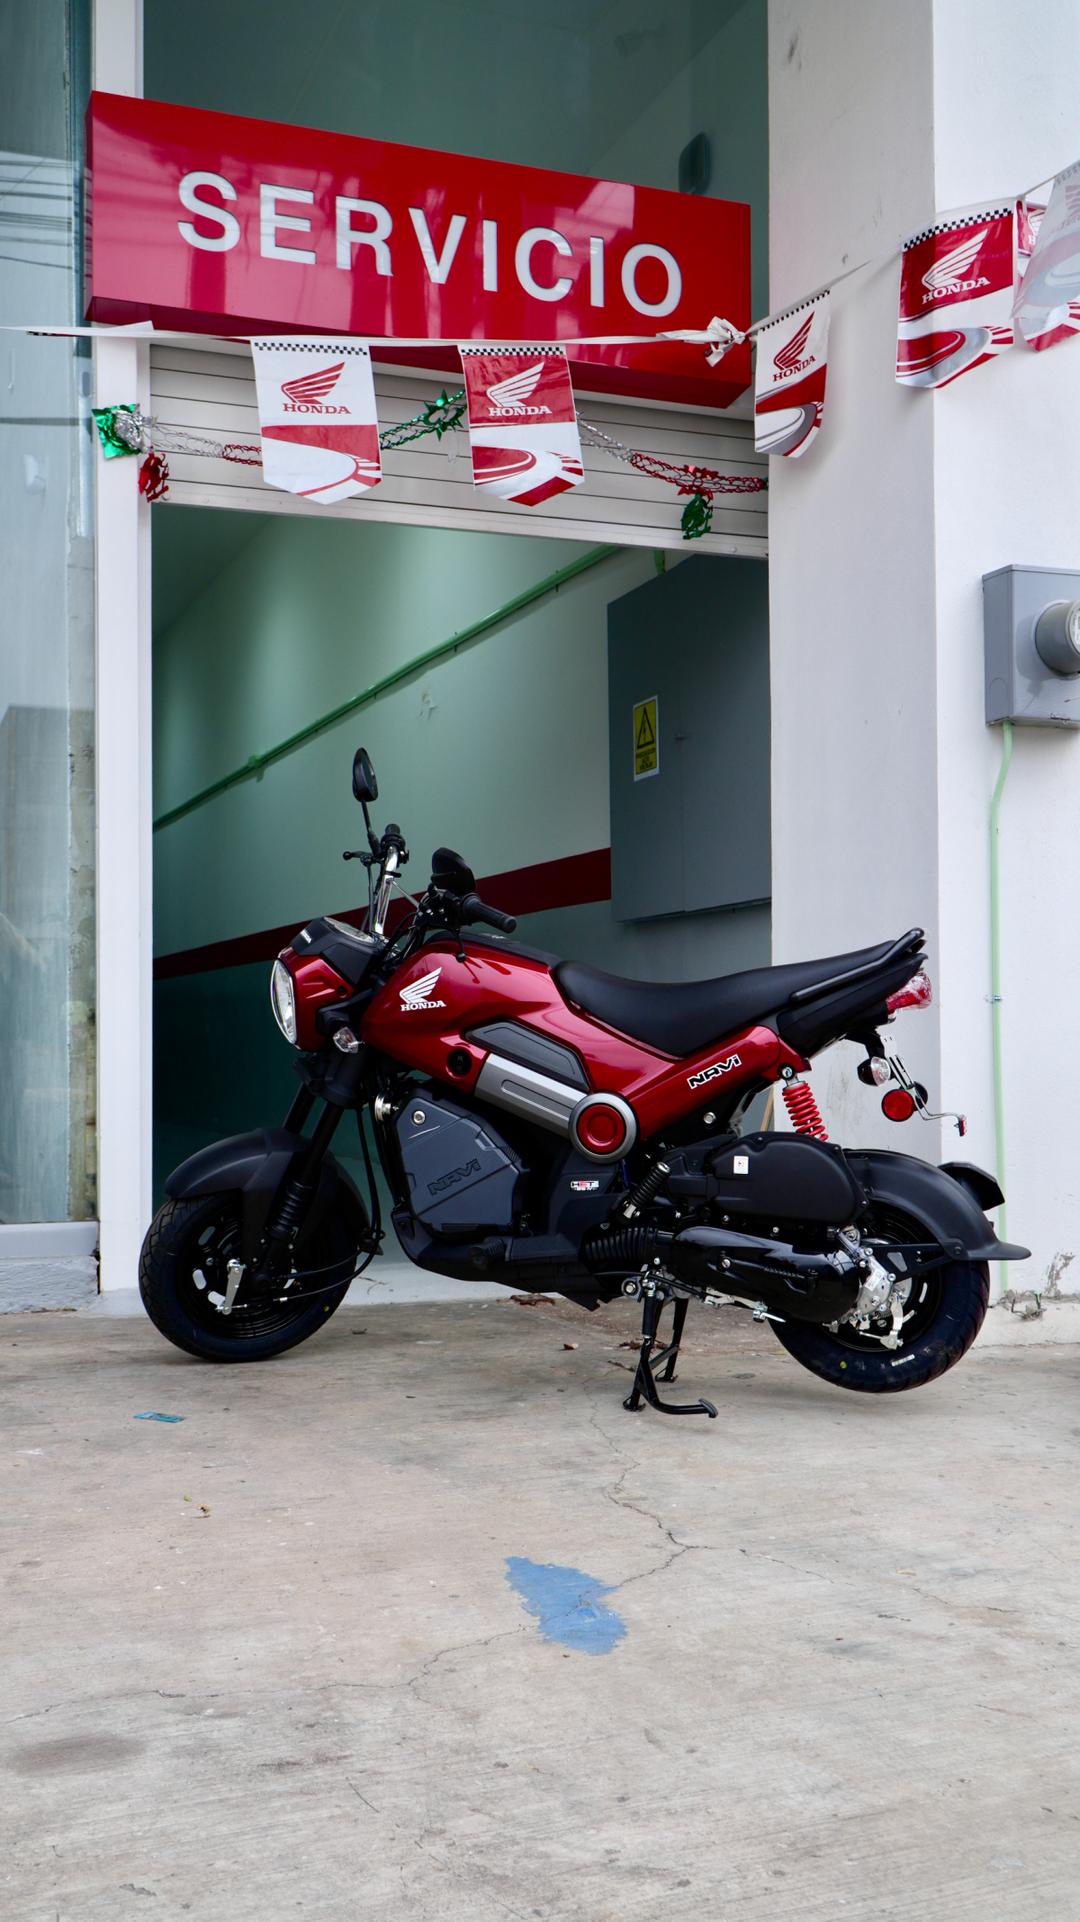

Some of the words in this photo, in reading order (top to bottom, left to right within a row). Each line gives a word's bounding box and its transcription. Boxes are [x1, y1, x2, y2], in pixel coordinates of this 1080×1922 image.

[176, 170, 683, 317] SERVICIO
[922, 276, 991, 304] HONDA
[772, 355, 816, 382] HONDA
[282, 403, 352, 414] HONDA
[488, 405, 553, 416] HONDA
[400, 1000, 447, 1011] HONDA
